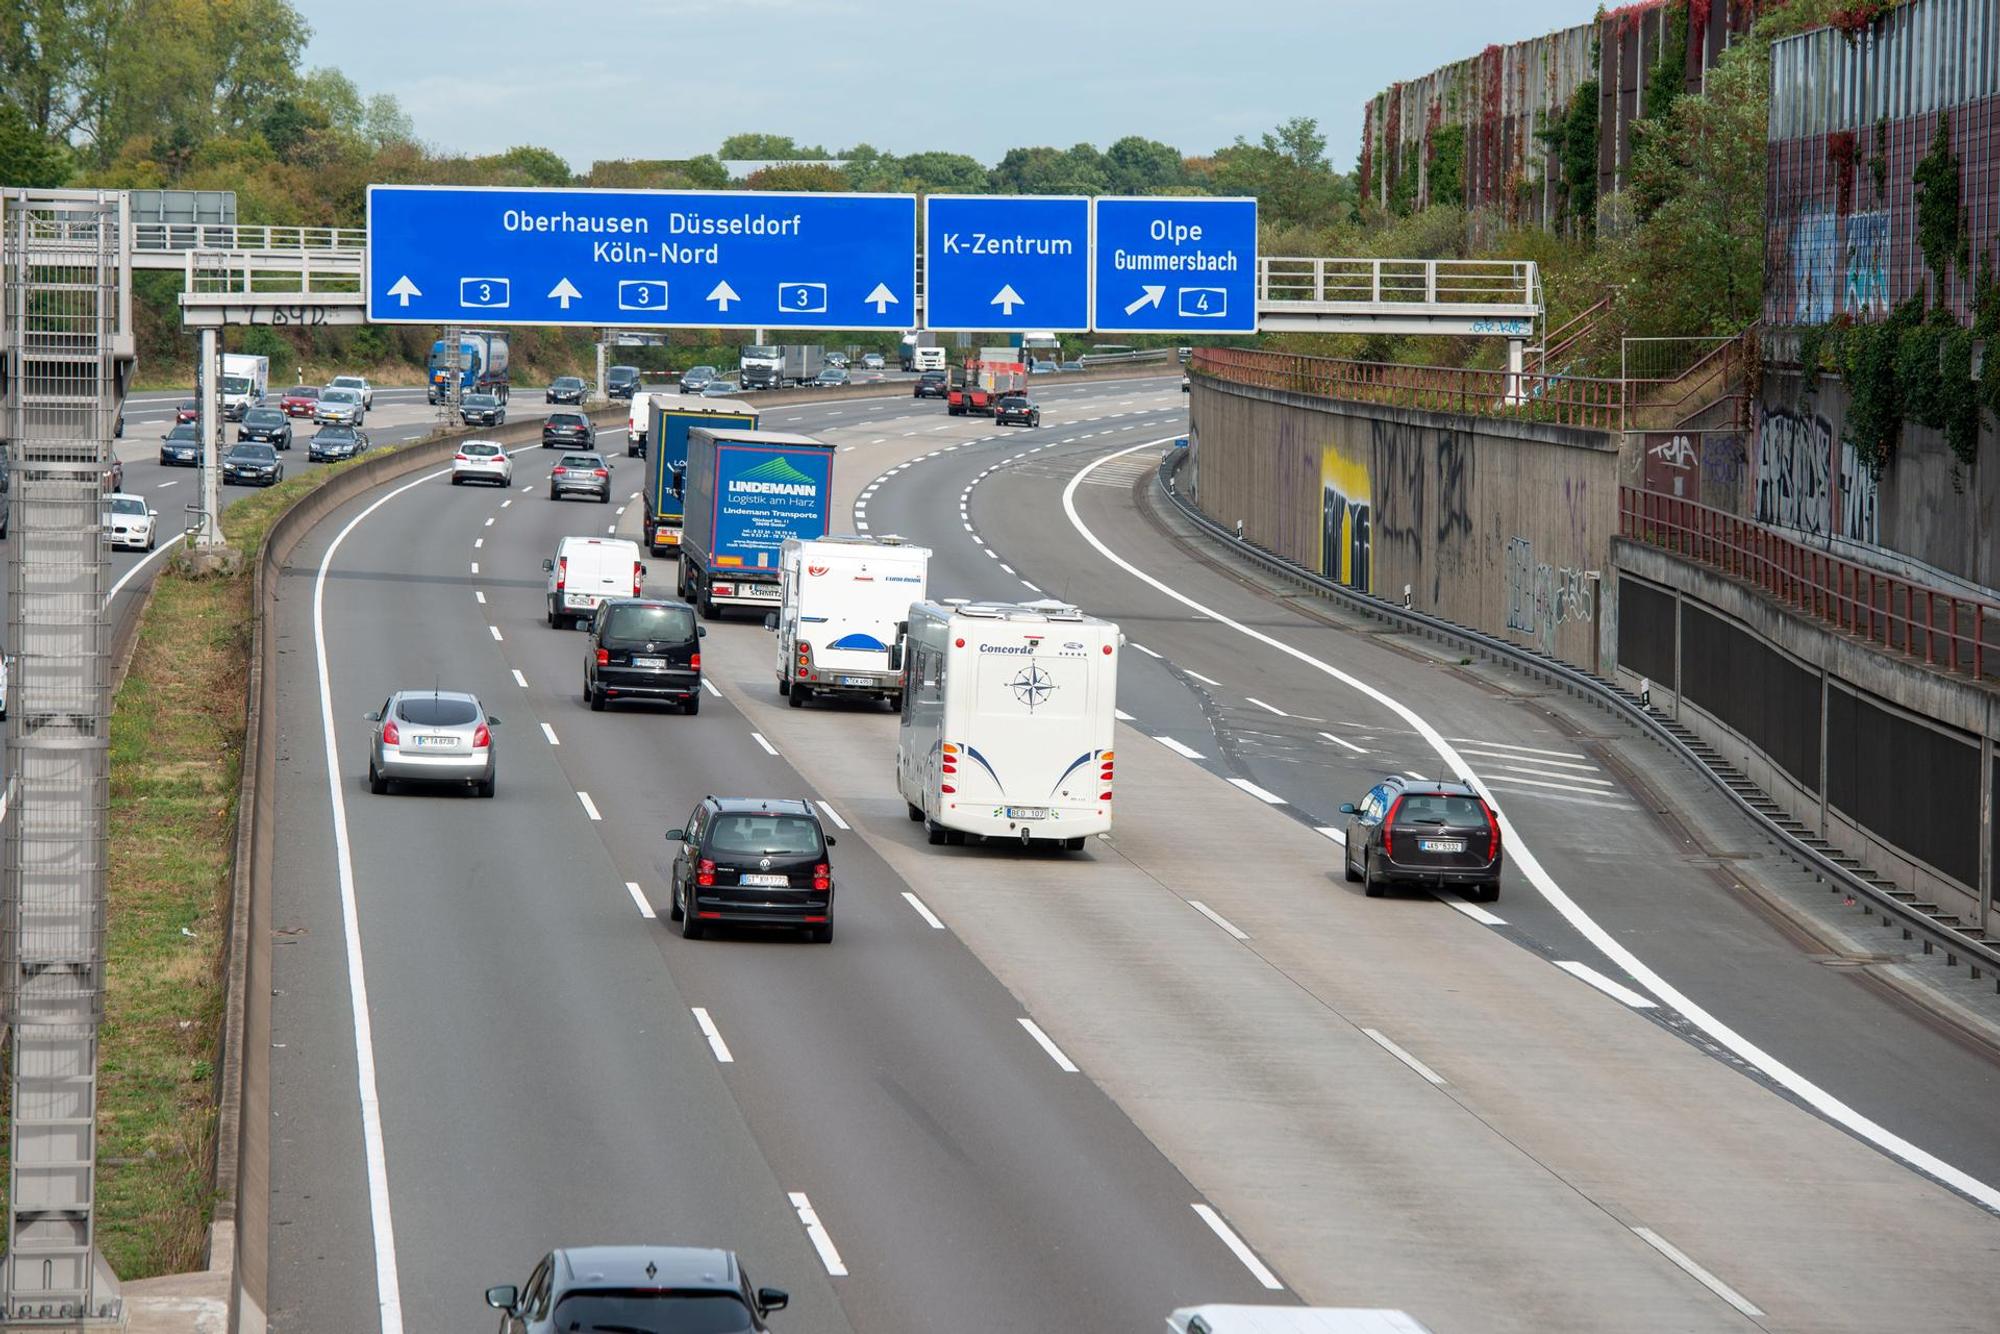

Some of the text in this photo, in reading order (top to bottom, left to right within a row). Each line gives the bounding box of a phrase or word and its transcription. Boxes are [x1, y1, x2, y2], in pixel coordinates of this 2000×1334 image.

[503, 210, 801, 236] Oberhausen Düsseldorf
[1150, 219, 1202, 246] Olpe
[593, 241, 718, 264] Köln-Nord
[943, 233, 1072, 255] K-Zentrum
[1114, 249, 1237, 272] Gummersbach
[479, 284, 491, 302] 3
[638, 286, 649, 304] 3
[797, 288, 809, 306] 3
[1196, 293, 1209, 311] 4
[728, 480, 816, 497] LINDEMANN
[728, 494, 815, 508] Logistik am Harz
[723, 507, 818, 519] Lindemann Transporte
[979, 643, 1034, 656] Concorde
